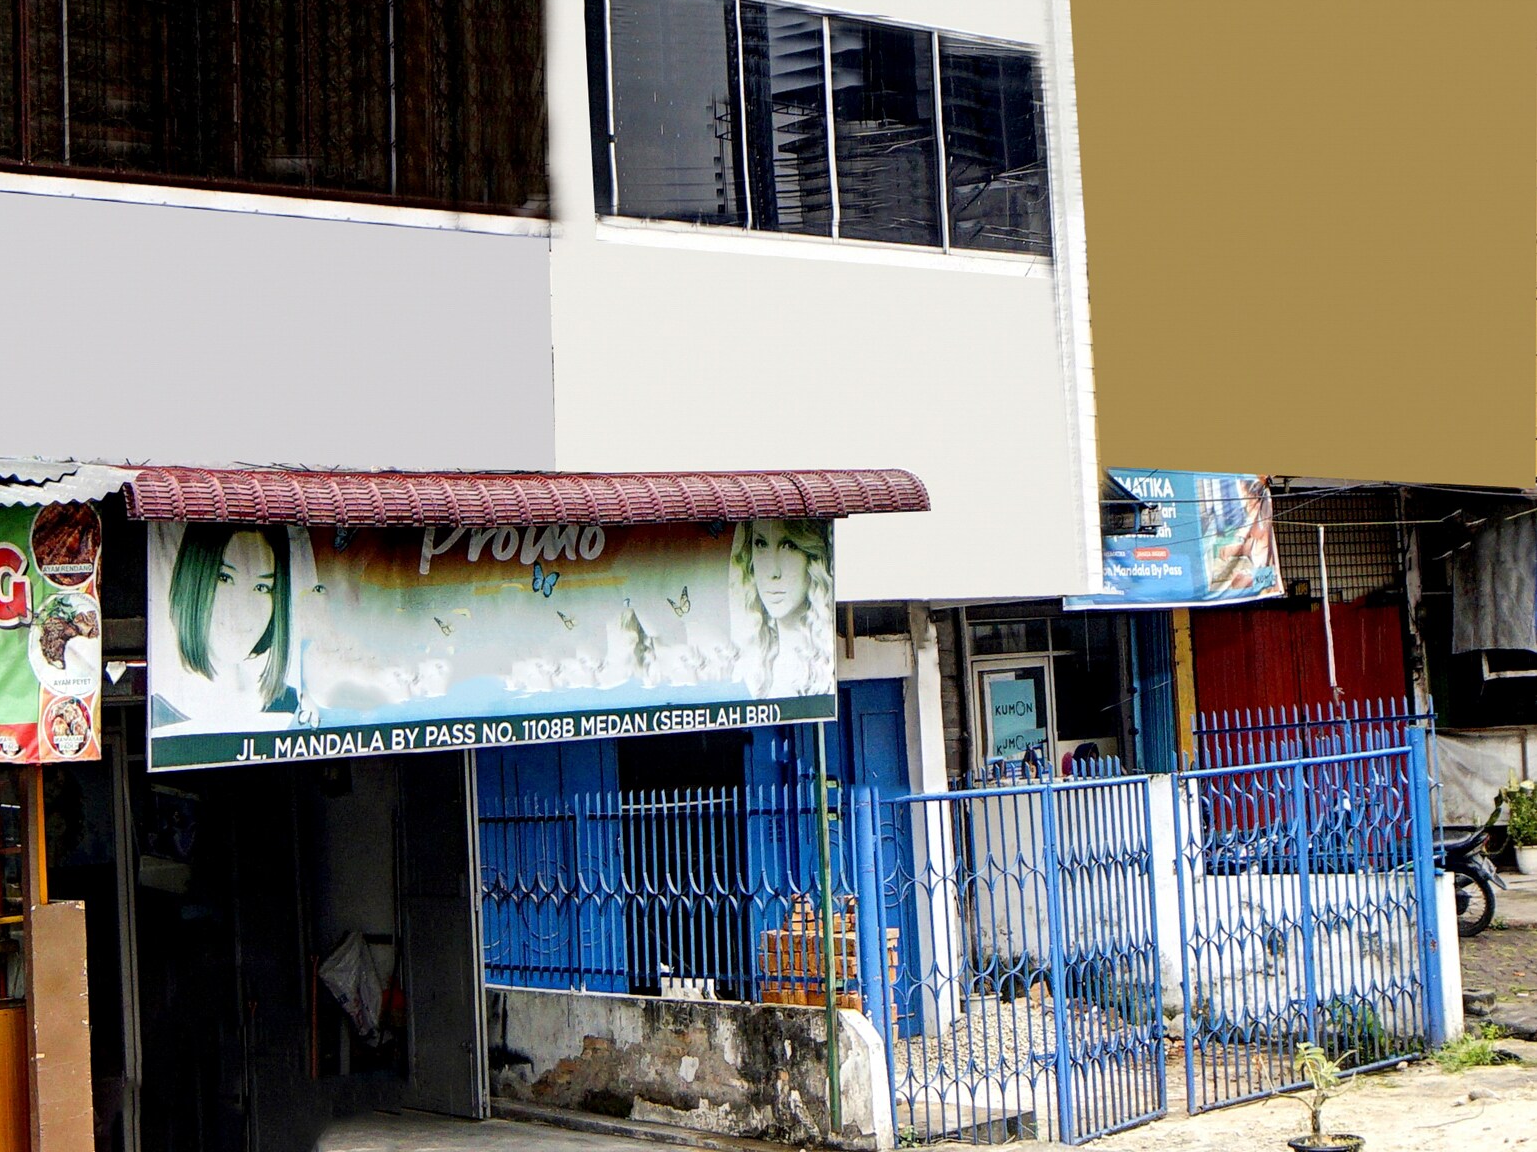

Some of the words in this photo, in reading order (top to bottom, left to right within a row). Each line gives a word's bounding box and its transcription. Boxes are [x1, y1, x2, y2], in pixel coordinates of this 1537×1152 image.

[1113, 563, 1150, 576] Mandala
[1151, 564, 1162, 579] By
[1163, 564, 1183, 576] Pass
[995, 701, 1033, 716] KUMON
[237, 738, 267, 761] JL.
[275, 730, 384, 759] MANDALA
[392, 727, 419, 750] BY
[425, 723, 475, 747] PASS
[482, 721, 516, 743] NO.
[522, 717, 574, 739] 1108B
[581, 713, 647, 736] MEDAN
[653, 705, 741, 732] (SEBELAH
[747, 703, 781, 724] BRI)
